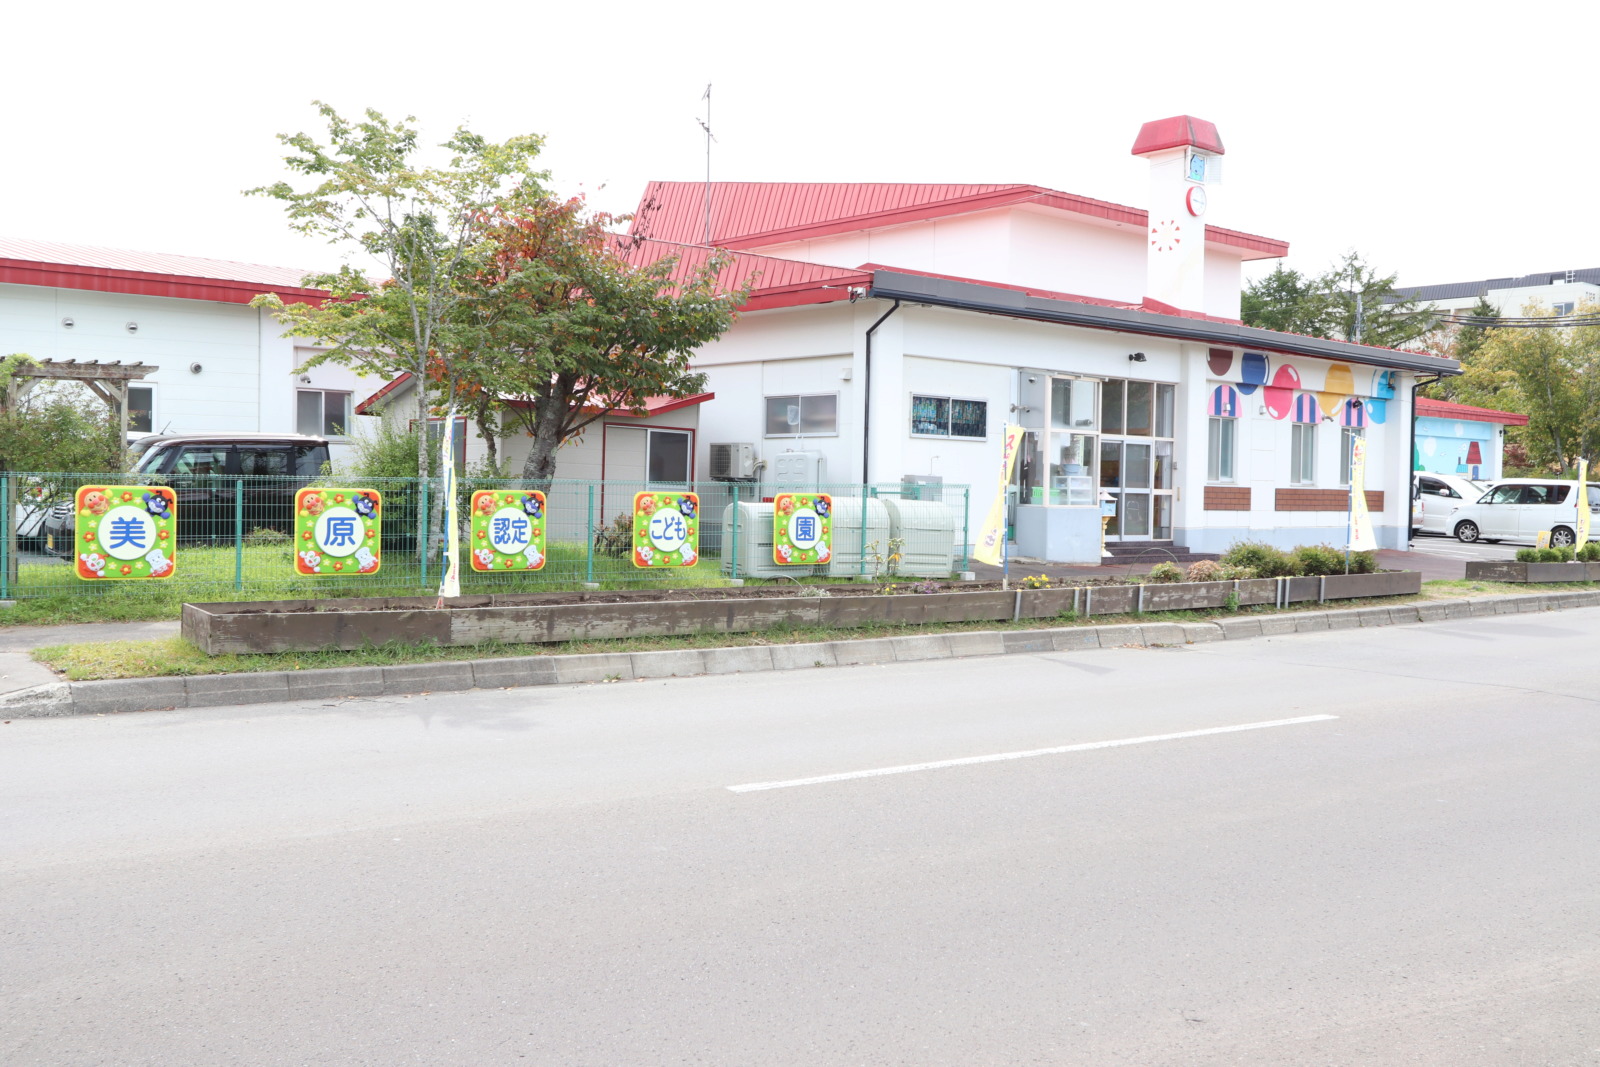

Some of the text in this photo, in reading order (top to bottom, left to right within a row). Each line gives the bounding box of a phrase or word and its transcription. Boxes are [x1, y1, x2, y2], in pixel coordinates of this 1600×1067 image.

[109, 516, 146, 549] 美
[323, 516, 357, 547] 原
[493, 516, 528, 544] 認定
[651, 516, 686, 540] こども
[796, 516, 815, 541] 園
